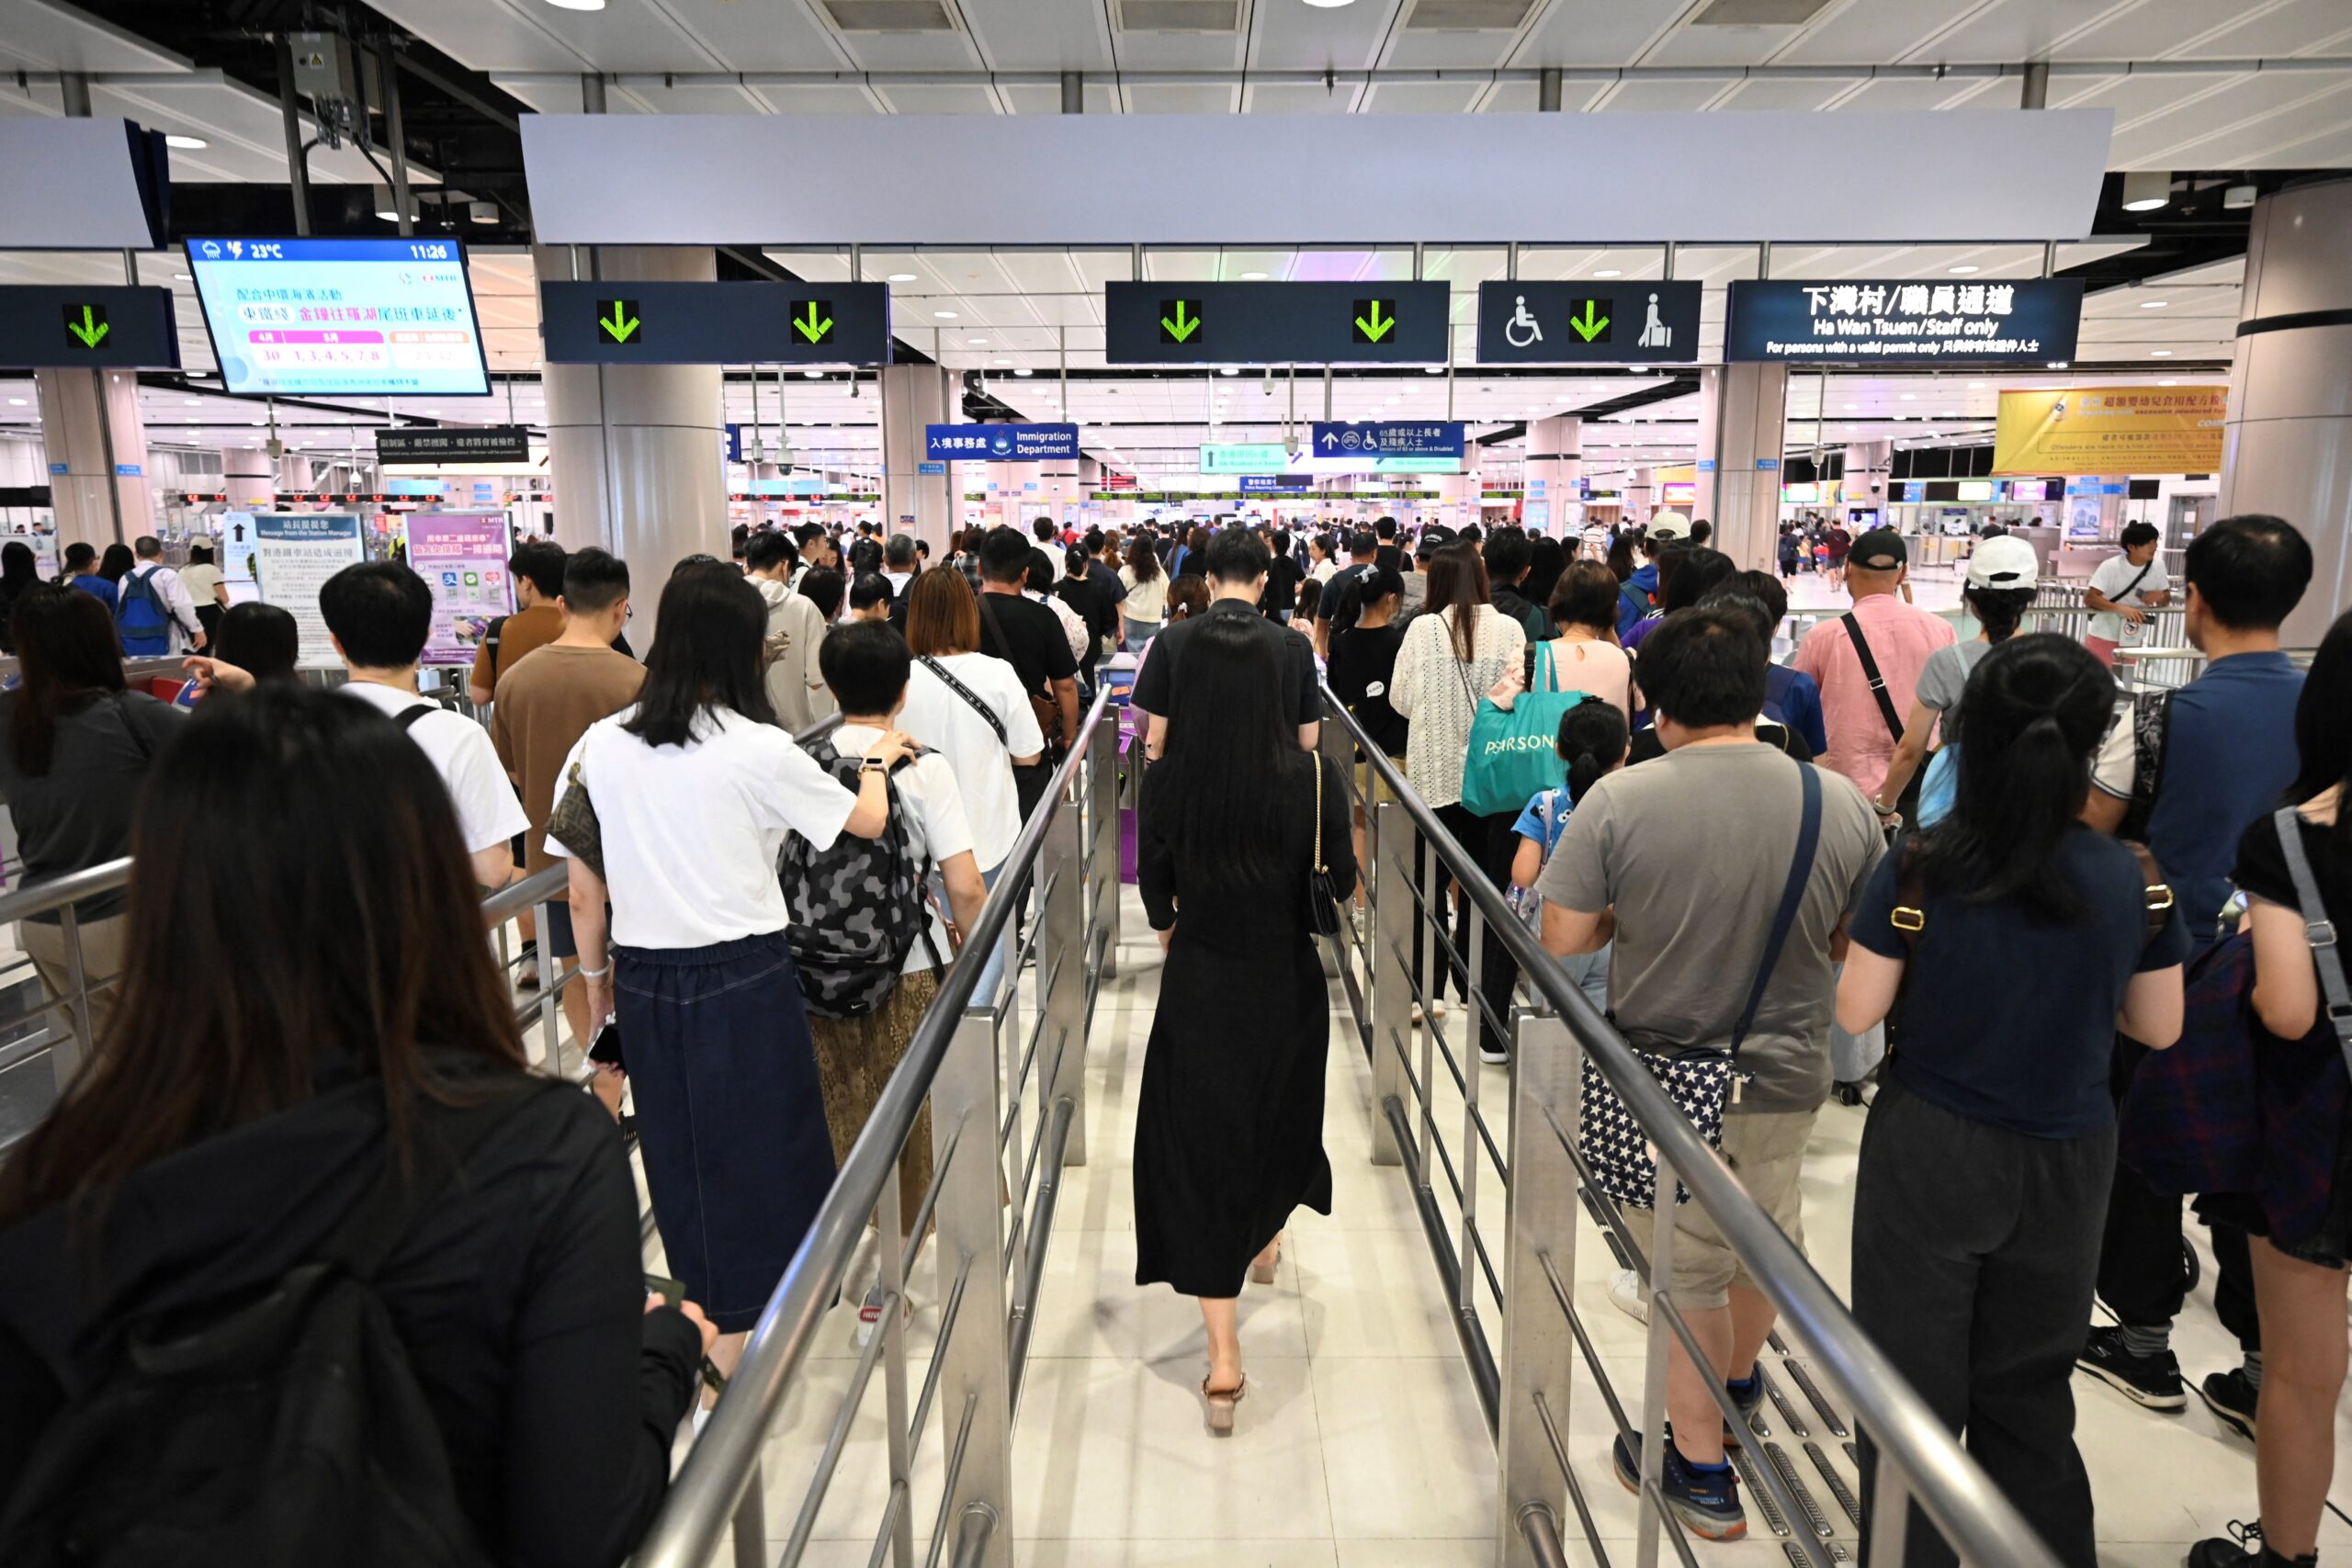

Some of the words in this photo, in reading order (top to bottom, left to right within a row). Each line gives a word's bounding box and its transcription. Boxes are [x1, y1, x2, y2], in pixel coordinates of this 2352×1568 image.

[250, 243, 283, 259] 23°C
[410, 244, 447, 259] 11:26
[1813, 318, 1835, 335] Ha
[1837, 318, 1871, 335] Wan
[1963, 317, 1999, 339] only
[1766, 341, 1784, 354] For
[1783, 343, 1825, 355] persons
[1825, 341, 1849, 354] with
[1849, 343, 1856, 354] a
[1857, 341, 1883, 354] valid
[1882, 341, 1917, 355] permit
[1917, 341, 1941, 355] only
[930, 436, 987, 449] 入境事務處
[1016, 431, 1072, 444] Immigration
[1016, 444, 1070, 457] Department
[328, 529, 352, 537] Manager
